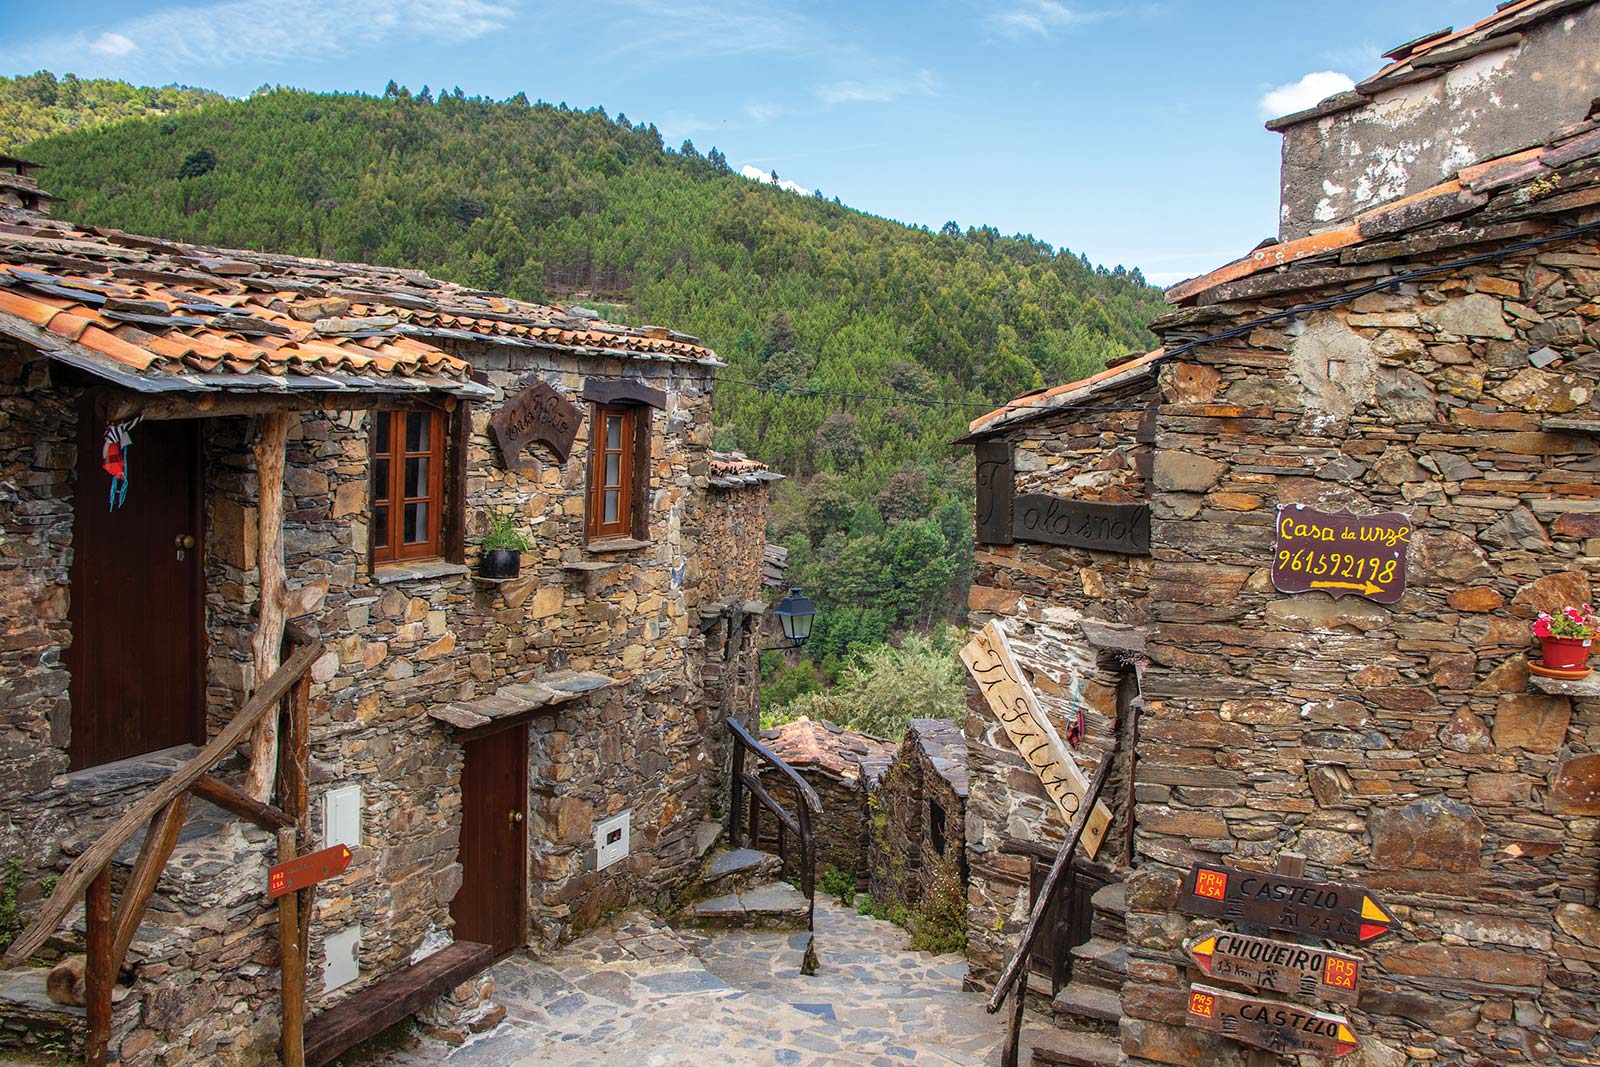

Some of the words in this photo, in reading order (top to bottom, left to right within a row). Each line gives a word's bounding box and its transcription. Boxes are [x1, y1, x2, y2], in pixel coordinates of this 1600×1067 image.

[1281, 517, 1335, 541] Casa
[1341, 526, 1356, 540] da
[272, 871, 285, 881] PR2
[1200, 872, 1223, 888] PR4
[271, 880, 284, 889] LSA
[1199, 885, 1221, 897] LSA
[1240, 878, 1338, 909] CASTELO
[1215, 935, 1322, 972] CHIQUEIRO
[1327, 957, 1354, 976] PR5
[1326, 972, 1351, 988] LSA
[1193, 993, 1213, 1006] PR5
[1191, 1003, 1211, 1016] LSA
[1239, 1004, 1338, 1038] CASTELO
